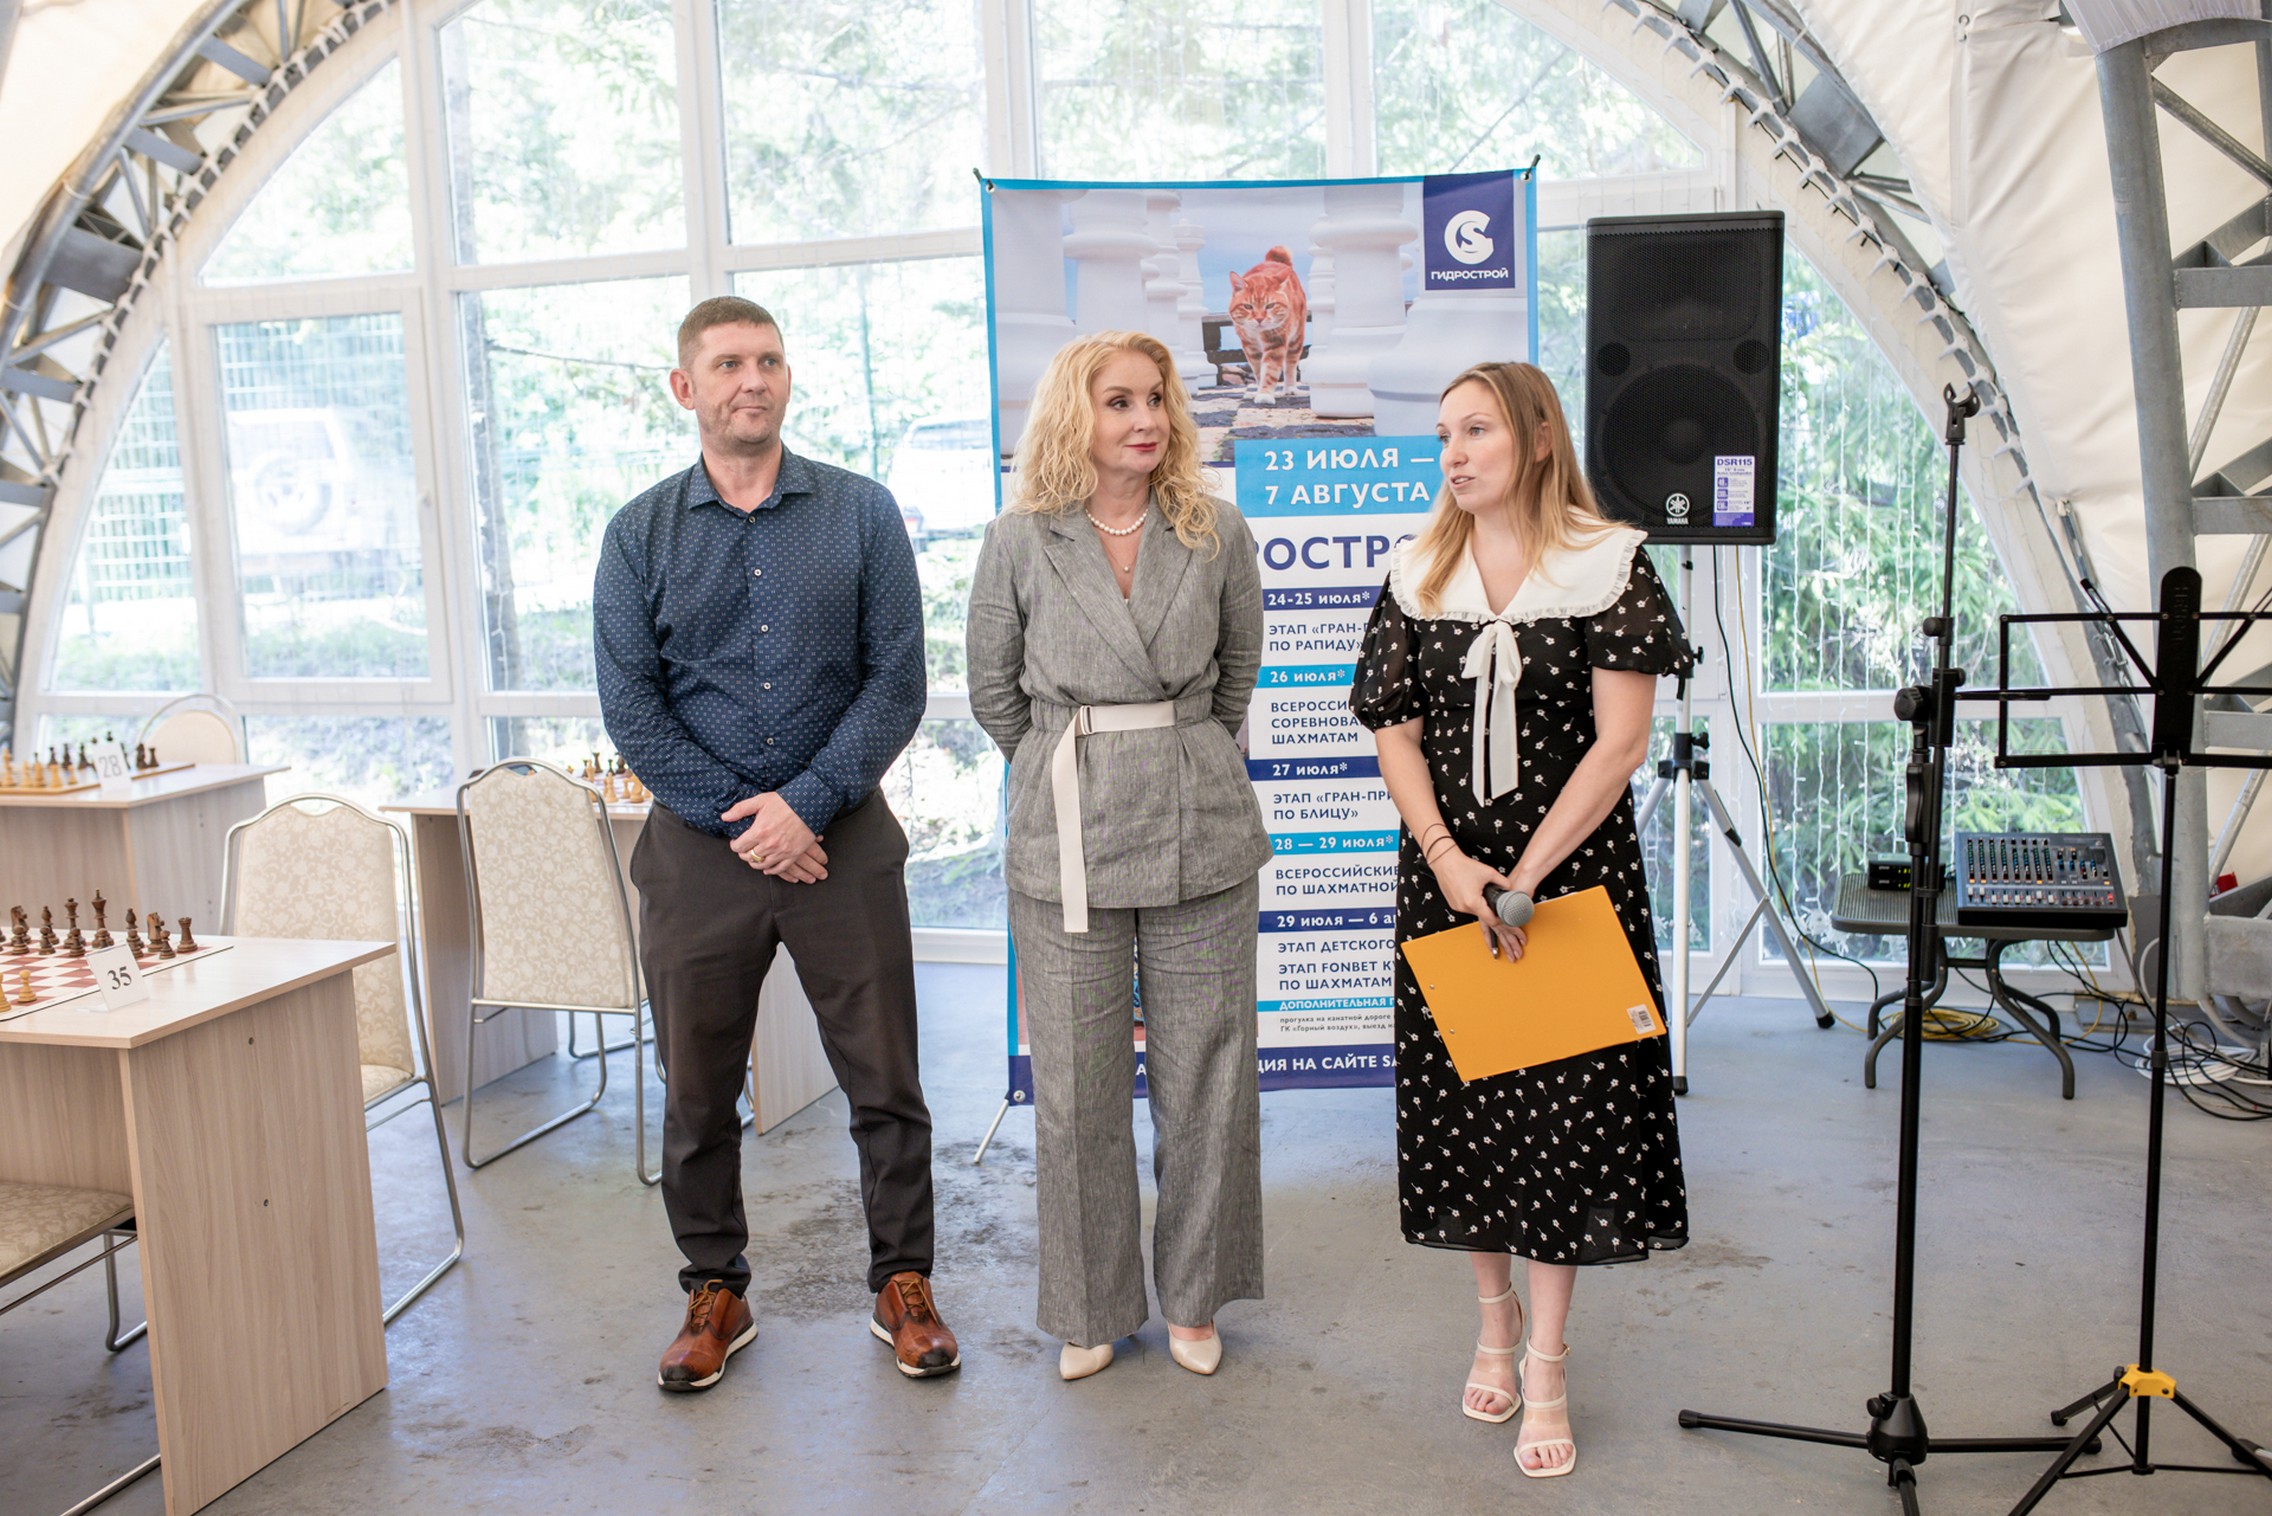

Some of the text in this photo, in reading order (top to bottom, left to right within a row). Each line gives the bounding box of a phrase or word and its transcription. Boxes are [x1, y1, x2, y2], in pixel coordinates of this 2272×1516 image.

[1431, 268, 1508, 281] ГИДРОСТРОЙ
[1264, 451, 1294, 470] 23
[1307, 448, 1398, 469] ИЮЛЯ
[1717, 458, 1752, 466] DSR115
[1265, 482, 1430, 508] 7 АВГУСТА
[1255, 534, 1418, 571] ОСТР
[1268, 593, 1312, 605] 24-25
[1269, 624, 1306, 635] ЭТАП
[1269, 639, 1362, 652] ПО РАПИДУ»
[1270, 671, 1288, 683] 26
[1271, 717, 1362, 728] СОРЕВНОВА
[1272, 732, 1358, 744] ШАХМАТАМ
[98, 755, 122, 778] 28
[1273, 764, 1290, 776] 27
[1274, 794, 1311, 804] ЭТАП
[1274, 808, 1358, 820] ПО БЛИЦУ»
[1275, 838, 1292, 850] 28
[1319, 837, 1336, 849] 29
[1276, 865, 1399, 880] ВСЕРОССИЙСКИЕ
[1276, 879, 1398, 895] ПО ШАХМАТНОЙ
[1277, 916, 1295, 927] 29
[1301, 916, 1343, 926] июля
[1369, 913, 1377, 924] 6
[1278, 940, 1395, 953] ЭТАП ДЕТСКОГО
[1279, 963, 1316, 974] ЭТАП
[1322, 961, 1377, 972] FONBET
[107, 966, 132, 990] 35
[1280, 978, 1391, 990] ПО ШАХМАТАМ
[1279, 998, 1386, 1010] ДОПОЛНИТЕЛЬНАЯ
[1293, 1058, 1317, 1070] НА
[1322, 1054, 1377, 1069] САЙТЕ
